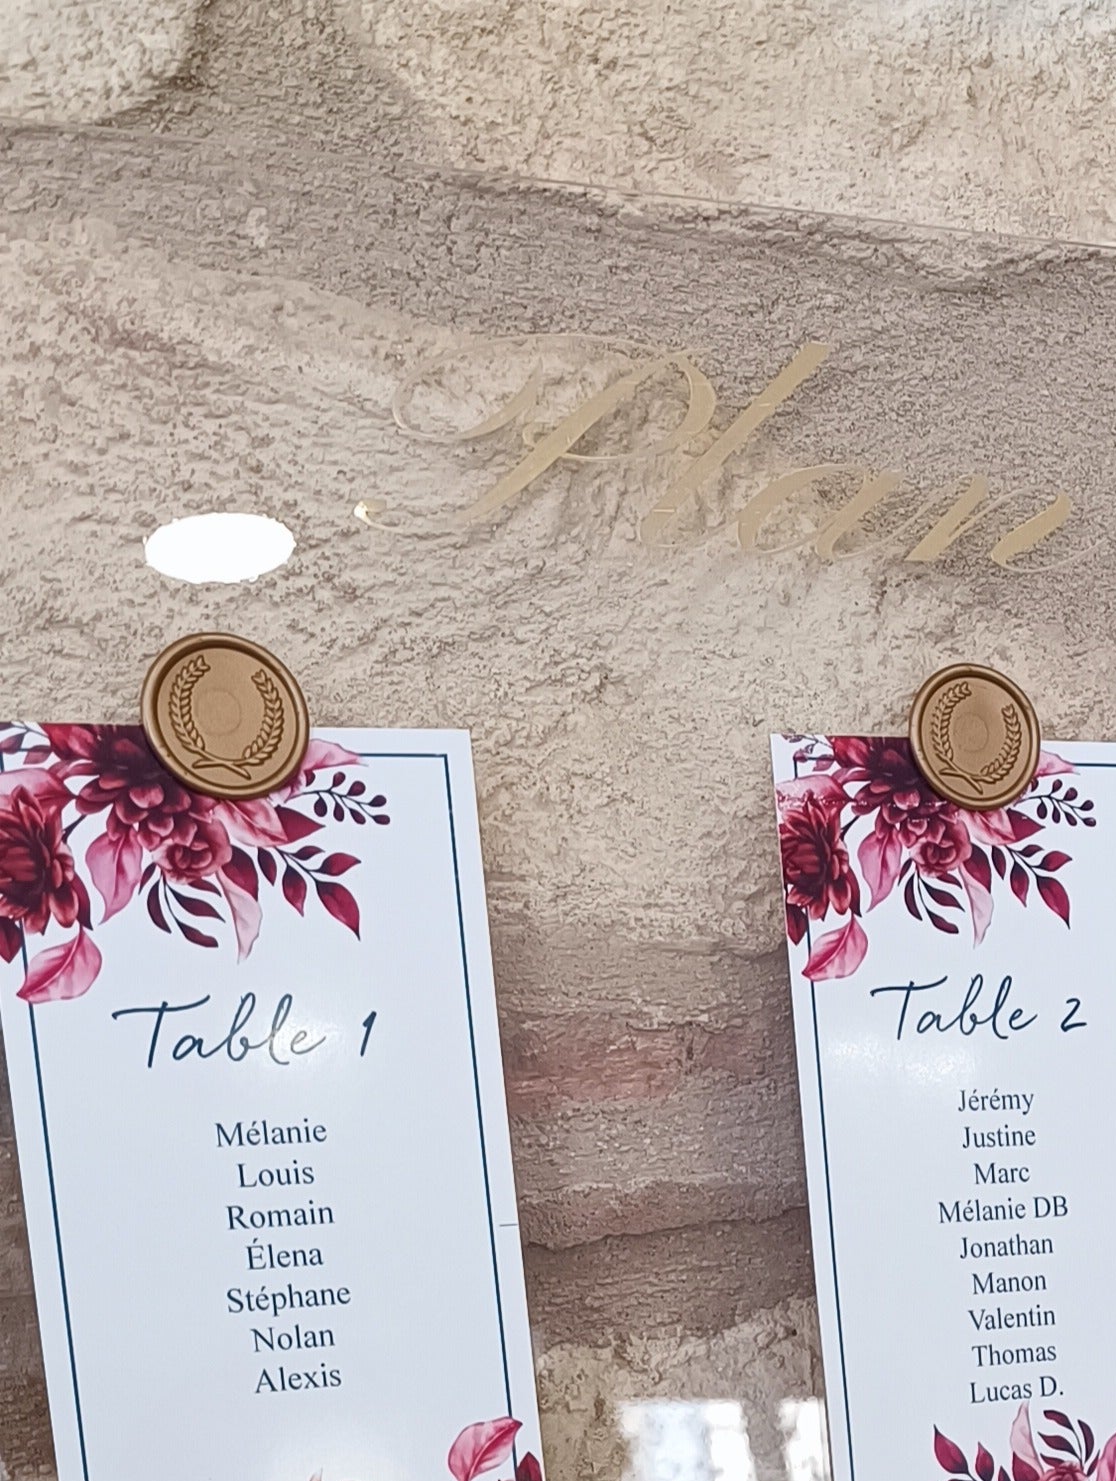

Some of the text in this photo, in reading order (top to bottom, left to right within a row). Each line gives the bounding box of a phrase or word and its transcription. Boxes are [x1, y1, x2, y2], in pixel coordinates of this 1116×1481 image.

[354, 334, 1102, 573] Plan
[870, 973, 1087, 1041] Table 2
[111, 992, 377, 1069] Table 1
[958, 1088, 1034, 1116] Jérémy
[215, 1118, 327, 1148] Mélanie
[962, 1123, 1036, 1149] Justine
[237, 1159, 315, 1188] Louis
[973, 1162, 1030, 1185] Marc
[226, 1199, 335, 1230] Romain
[938, 1195, 1068, 1224] Mélanie DB
[245, 1237, 324, 1270] Élena
[960, 1233, 1054, 1259] Jonathan
[972, 1272, 1047, 1295] Manon
[227, 1283, 351, 1318] Stéphane
[968, 1304, 1056, 1331] Valentin
[250, 1323, 335, 1352] Nolan
[971, 1343, 1057, 1367] Thomas
[255, 1362, 342, 1394] Alexis
[970, 1375, 1064, 1404] Lucas D.
